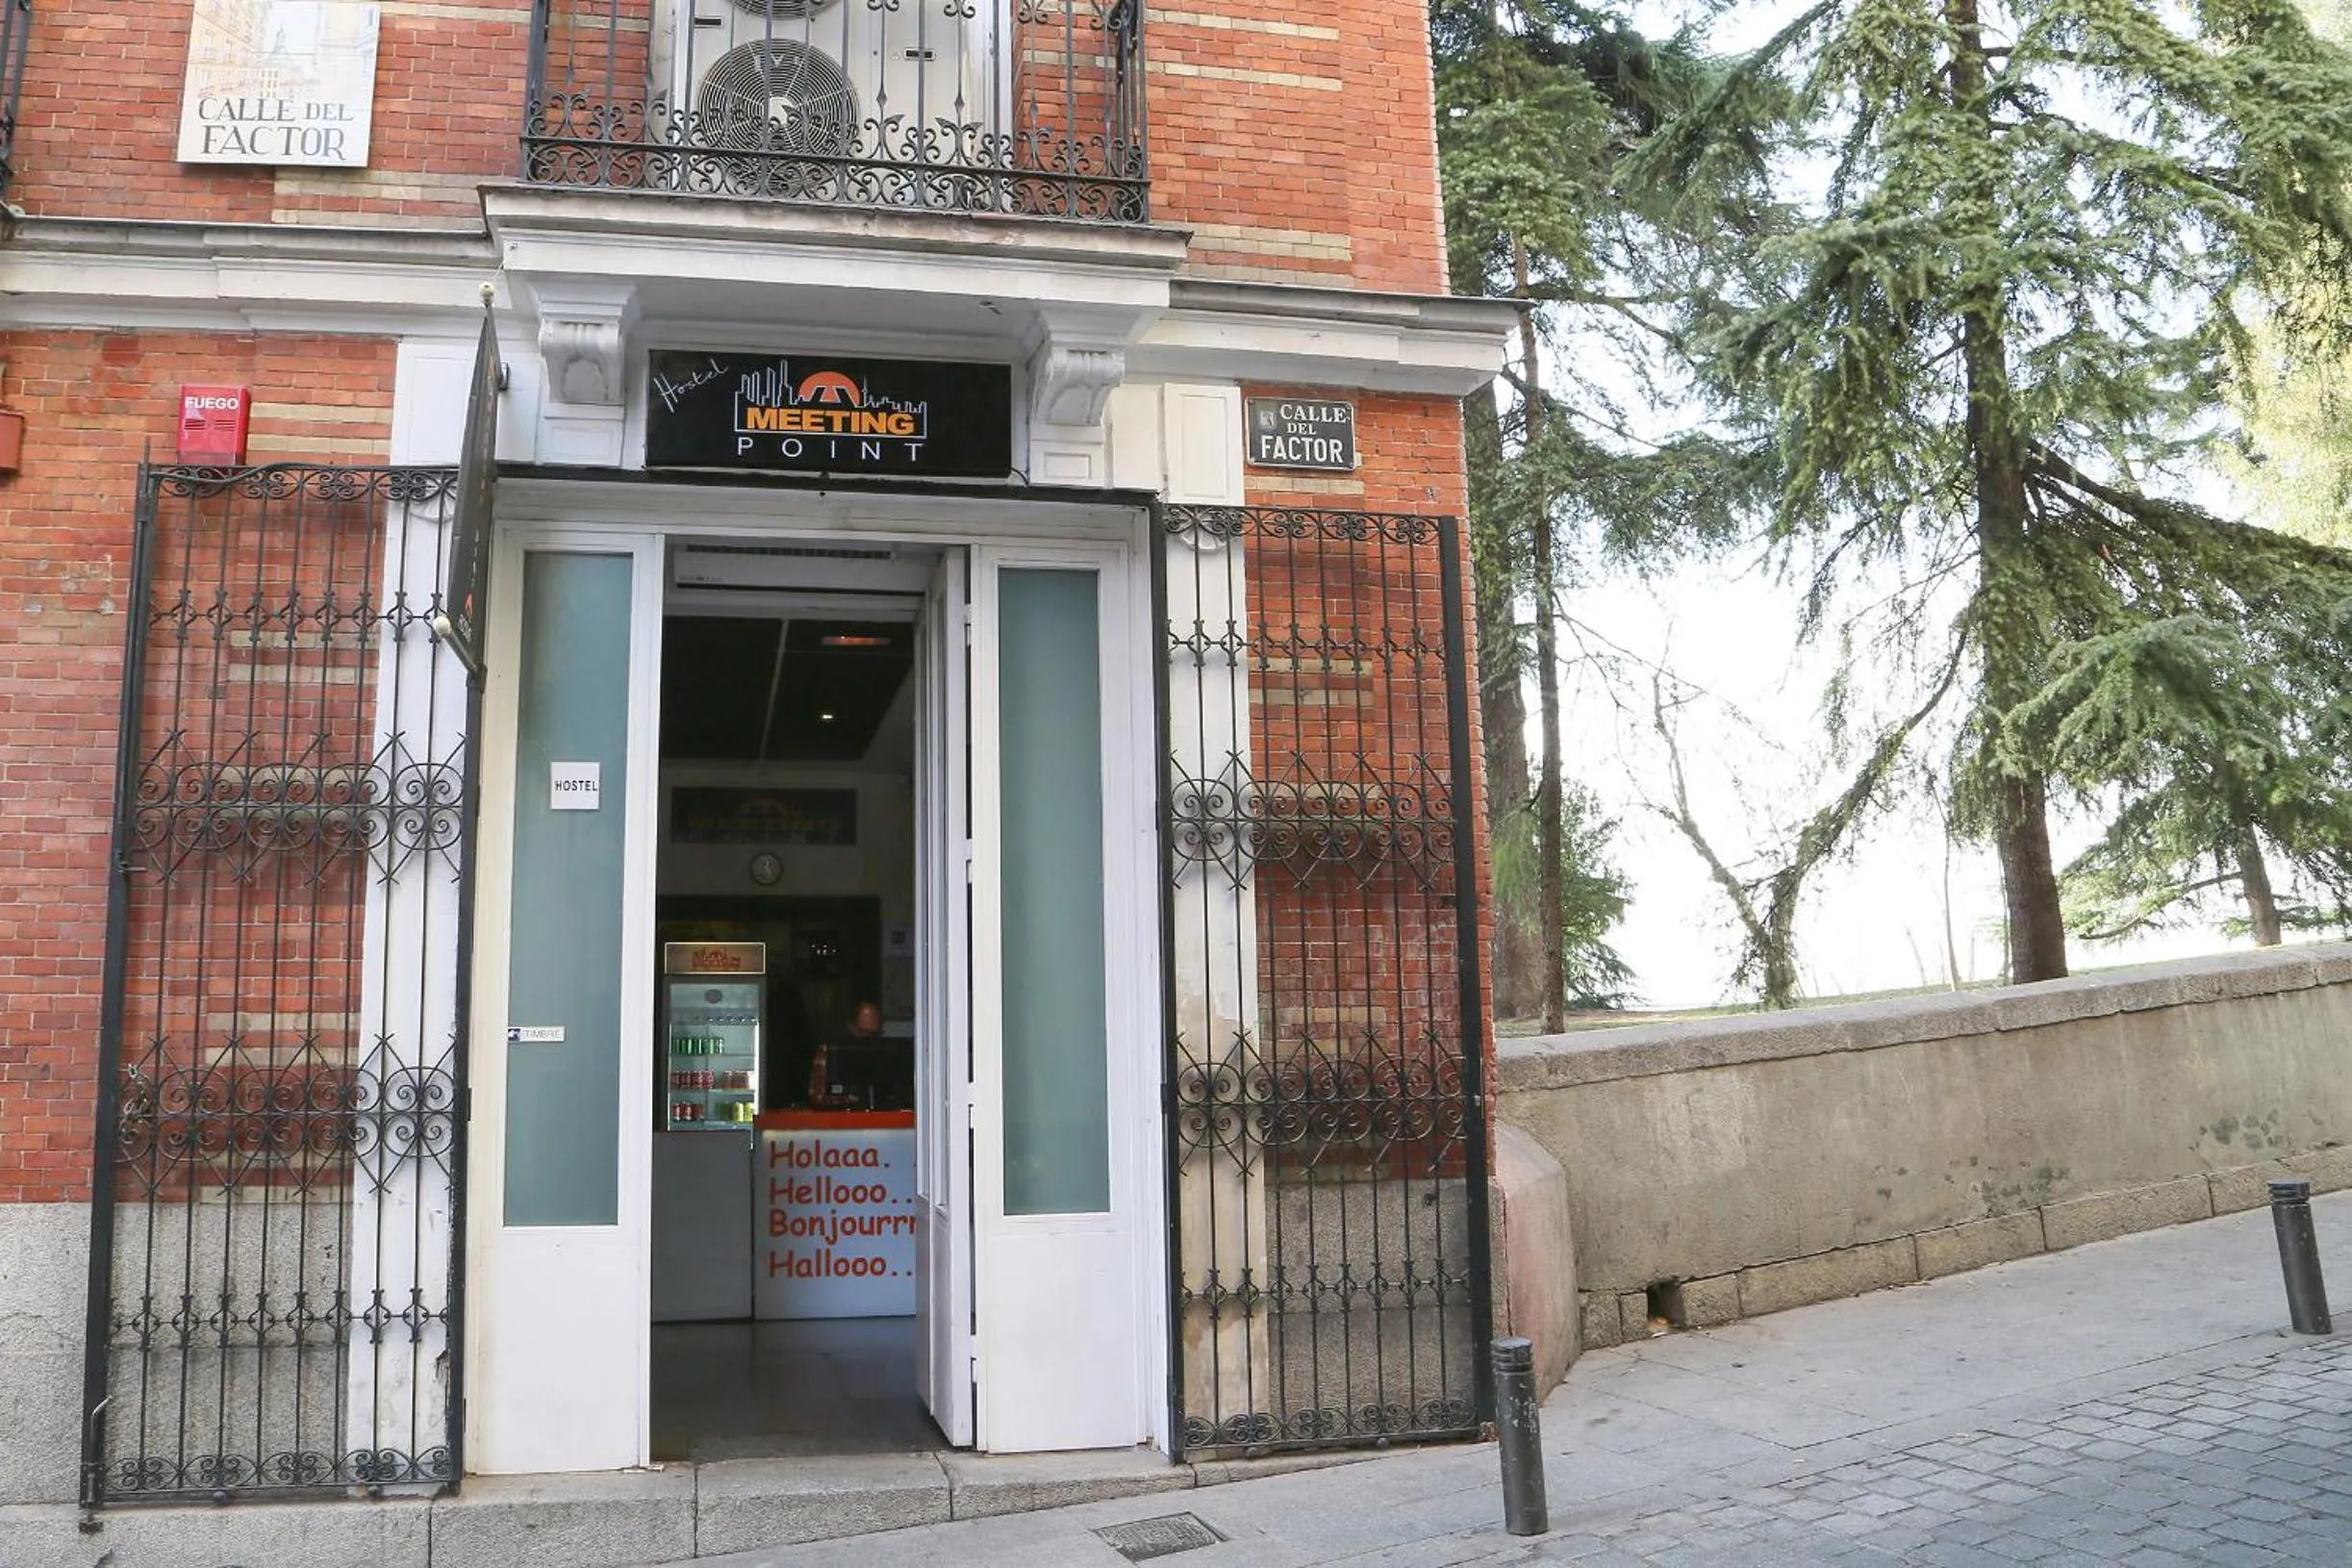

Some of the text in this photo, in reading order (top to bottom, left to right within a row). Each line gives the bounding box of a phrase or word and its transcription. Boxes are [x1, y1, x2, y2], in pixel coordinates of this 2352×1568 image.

[198, 97, 354, 121] CALLE DEL
[200, 124, 346, 161] FACTOR
[654, 359, 728, 413] Hostel
[185, 396, 240, 410] FUEGO
[1279, 403, 1347, 423] CALLE
[746, 407, 915, 435] MEETING
[1287, 422, 1317, 436] DEL
[737, 437, 924, 462] POINT
[1261, 435, 1344, 464] FACTOR
[555, 780, 598, 791] HOSTEL
